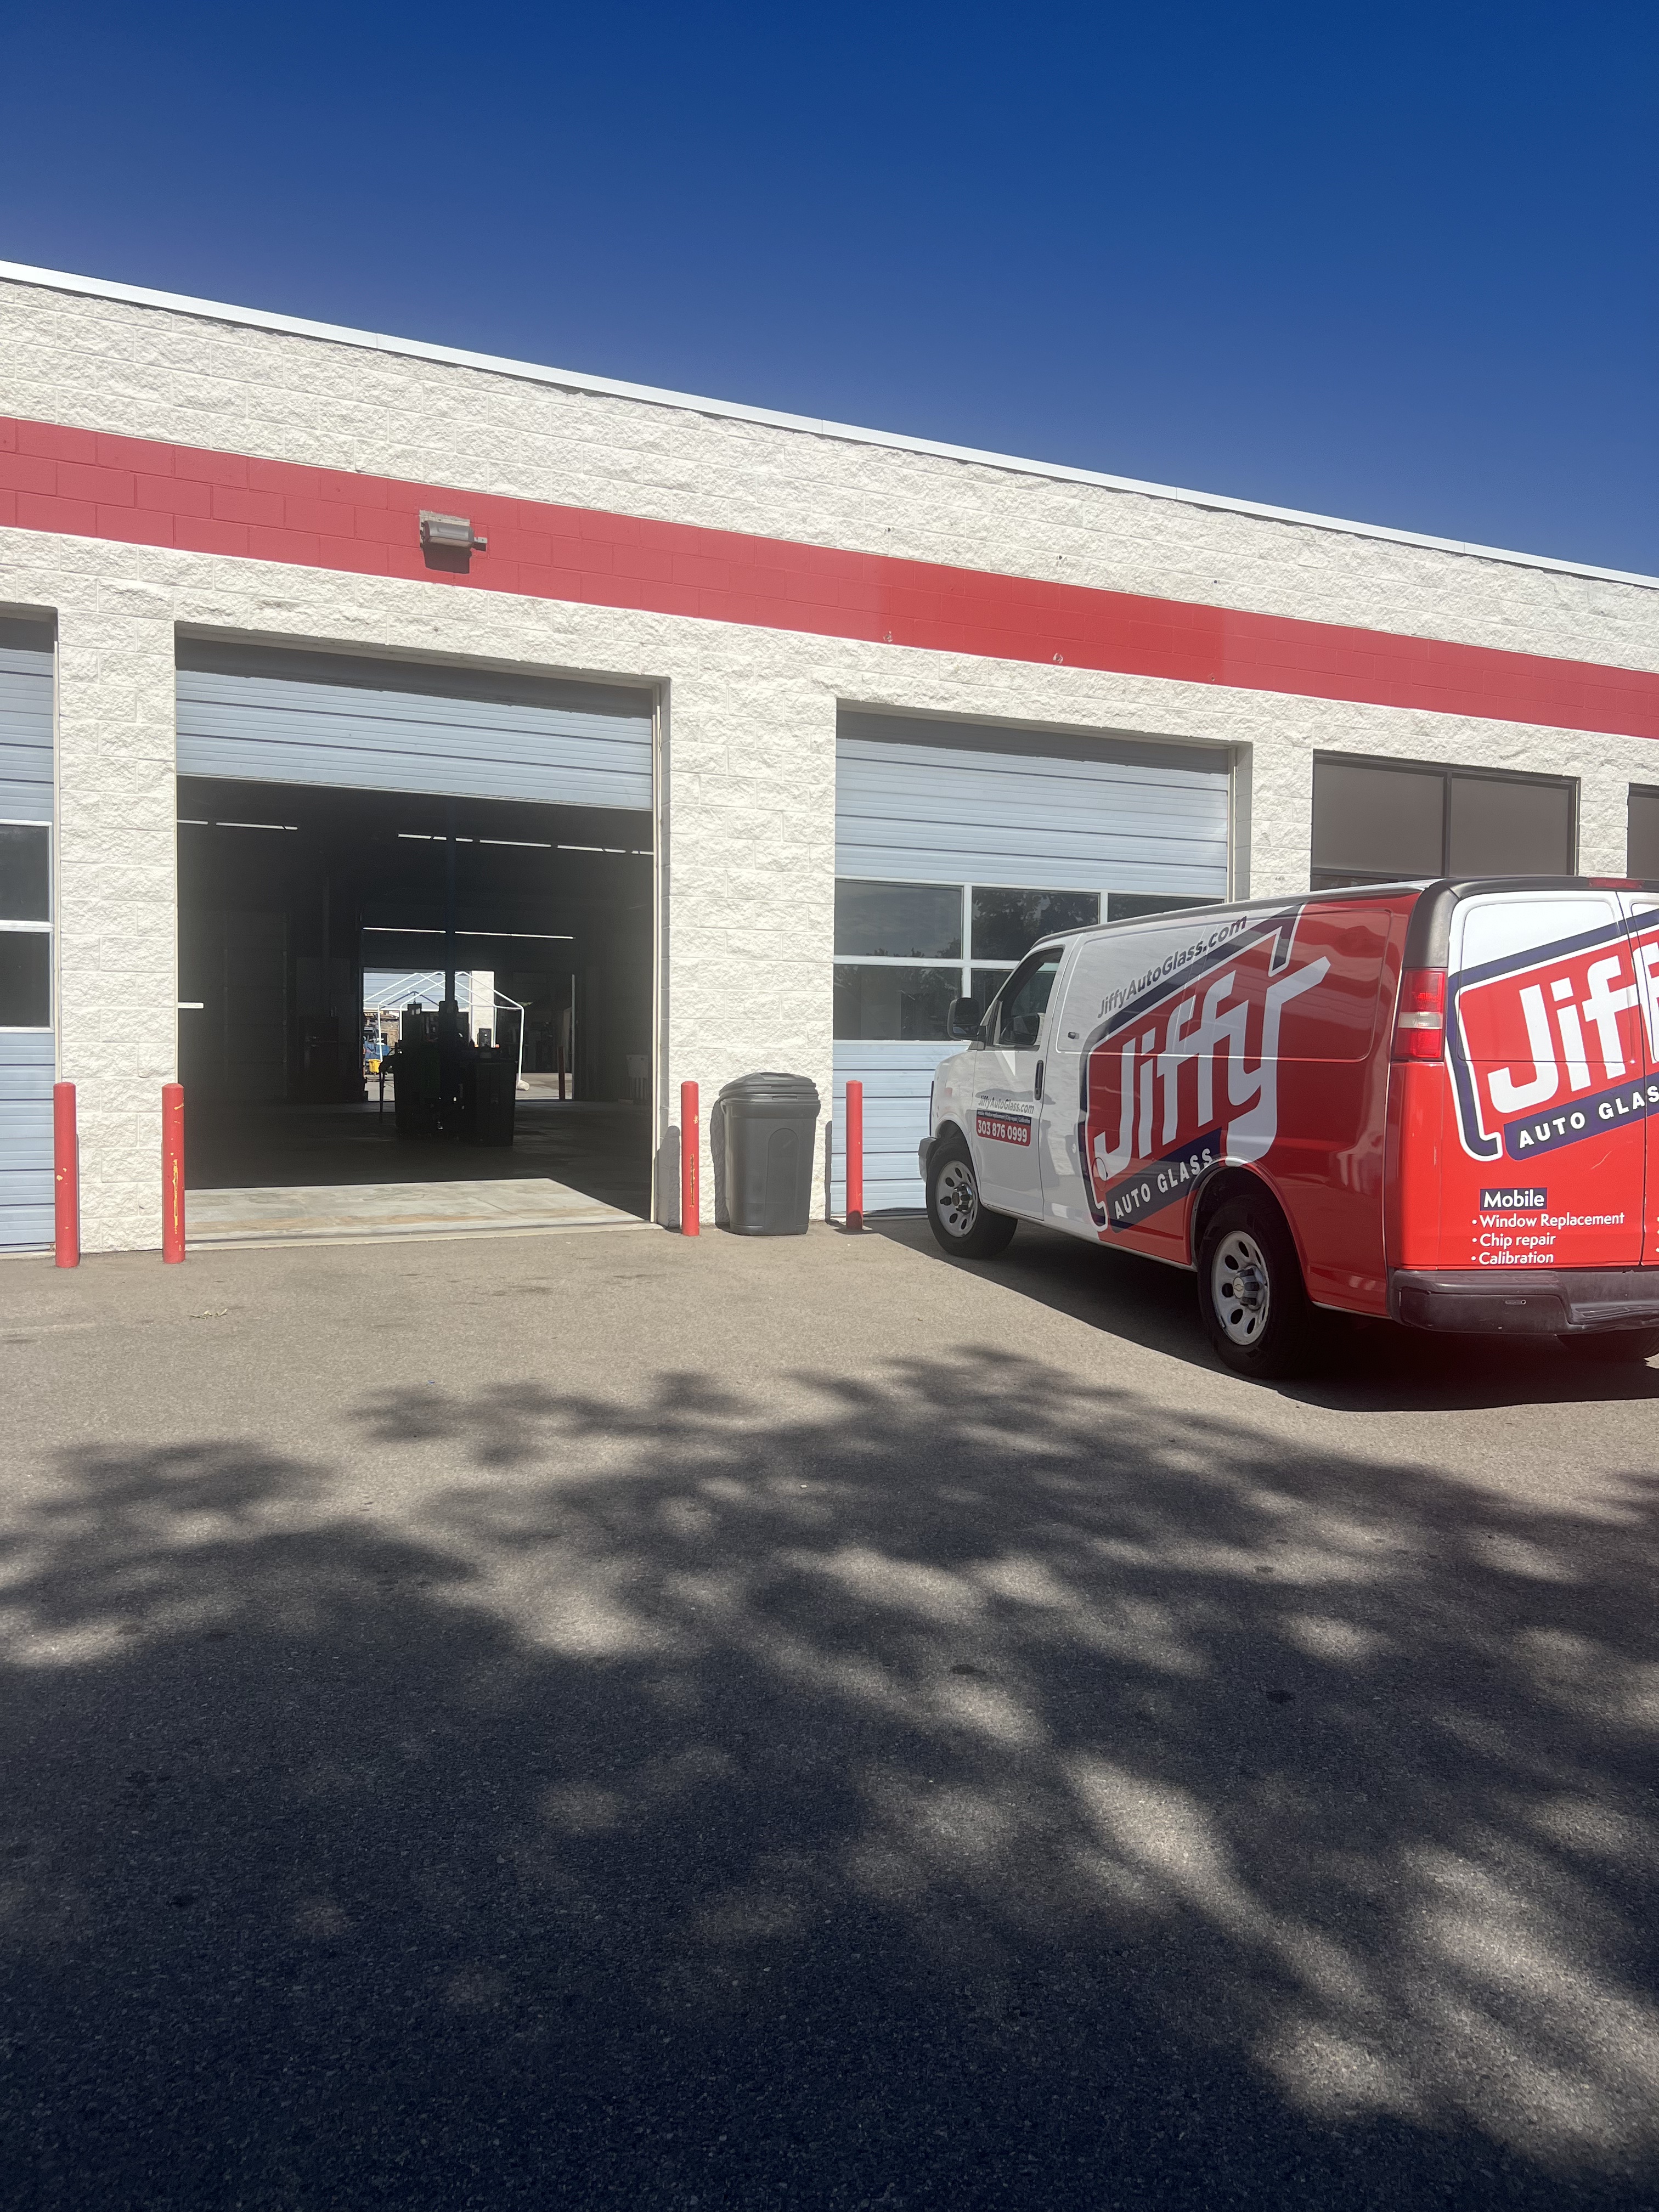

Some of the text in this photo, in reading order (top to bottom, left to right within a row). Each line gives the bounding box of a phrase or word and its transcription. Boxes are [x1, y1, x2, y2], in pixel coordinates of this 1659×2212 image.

[1098, 916, 1246, 1019] JiffyAutoGlass.com
[1093, 956, 1331, 1181] Jiffy
[978, 1095, 1034, 1114] JiffyAutoGlass.com
[1519, 1086, 1659, 1149] AUTO GLAS
[978, 1120, 1027, 1143] 303 876 0999
[1114, 1148, 1213, 1220] AUTO GLASS
[1483, 1189, 1545, 1207] Mobile
[1479, 1212, 1625, 1230] Window Replacement
[1480, 1232, 1556, 1249] Chip repair
[1479, 1251, 1554, 1265] Calibration
